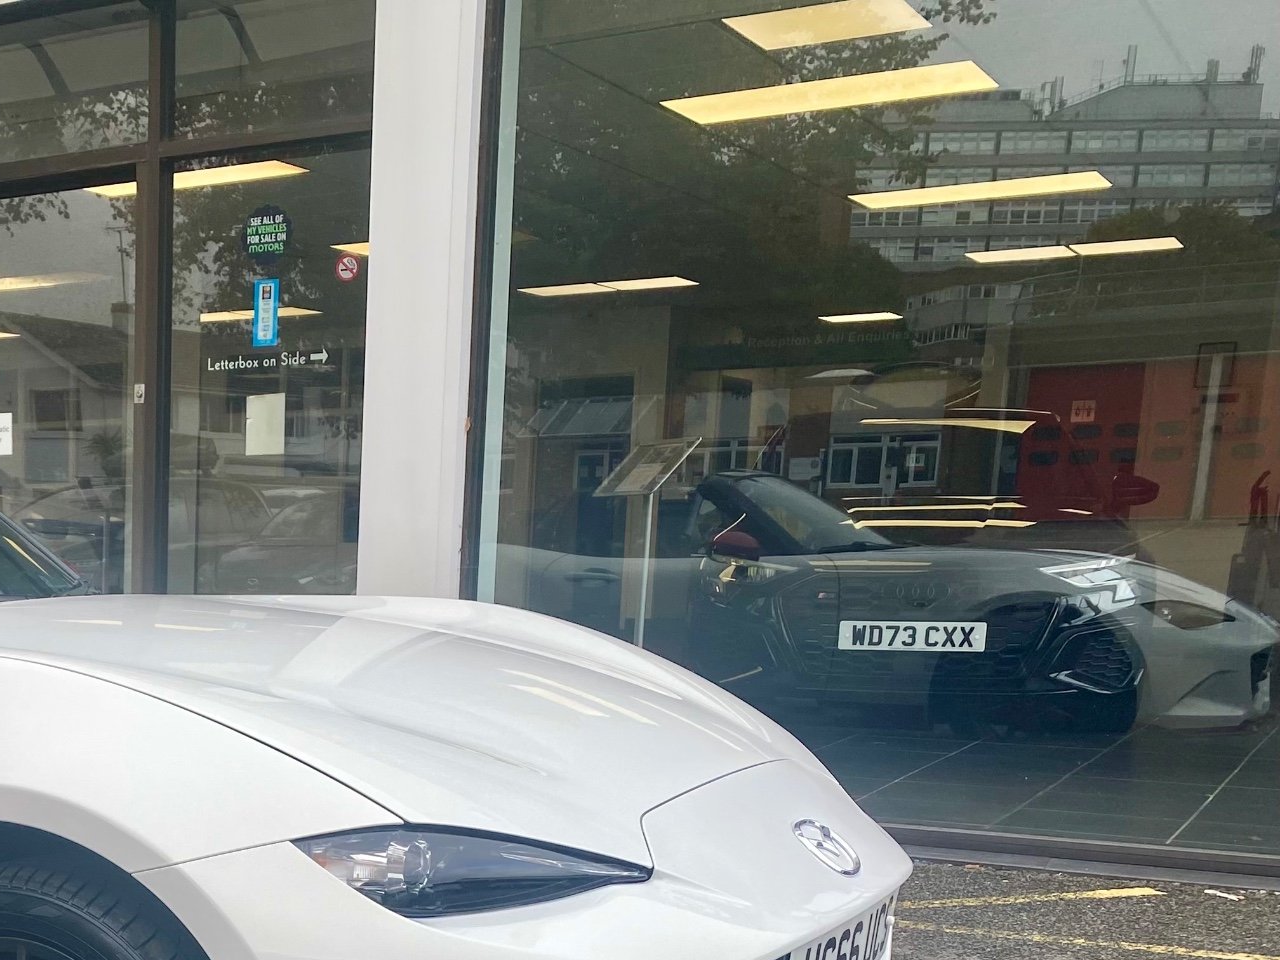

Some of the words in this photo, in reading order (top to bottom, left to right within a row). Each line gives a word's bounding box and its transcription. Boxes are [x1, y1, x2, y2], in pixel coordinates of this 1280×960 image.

[250, 217, 262, 226] SEE
[263, 215, 274, 225] ALL
[275, 214, 284, 223] OF
[247, 226, 257, 235] MY
[257, 223, 287, 234] VEHICLES
[247, 235, 260, 245] FOR
[260, 233, 276, 243] SALE
[276, 232, 287, 241] ON
[826, 332, 845, 345] All
[207, 355, 259, 371] Letterbox
[263, 356, 276, 367] on
[280, 351, 306, 366] Side
[851, 624, 917, 647] WD73
[924, 625, 976, 648] CXX
